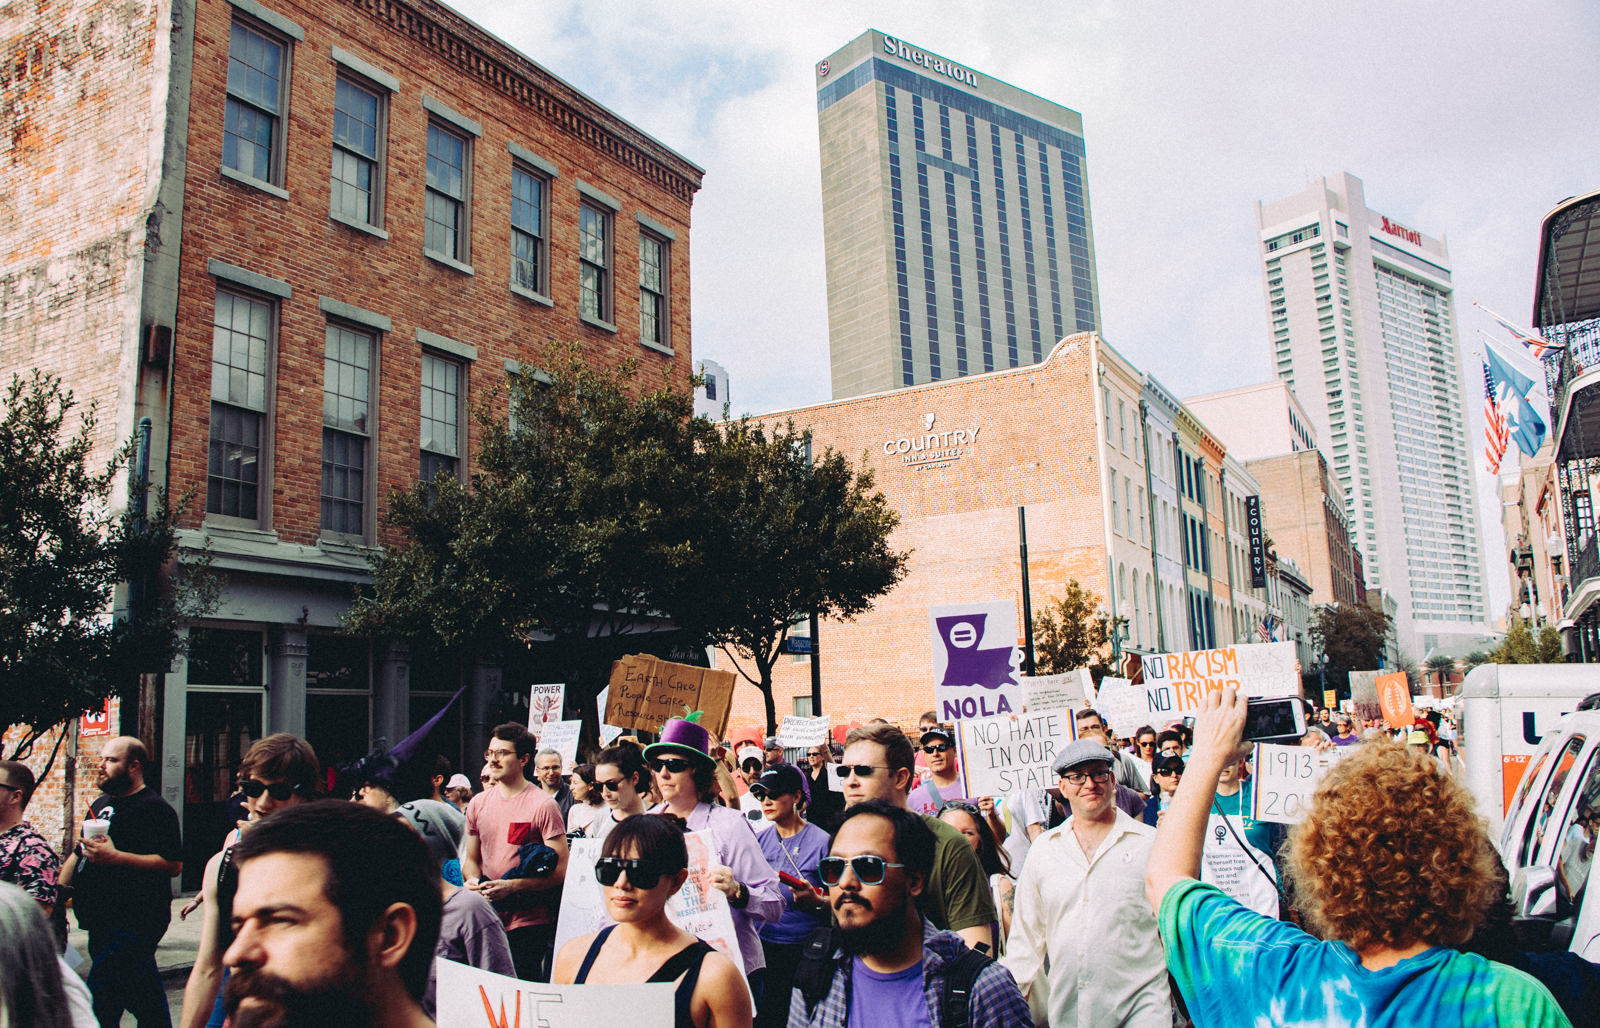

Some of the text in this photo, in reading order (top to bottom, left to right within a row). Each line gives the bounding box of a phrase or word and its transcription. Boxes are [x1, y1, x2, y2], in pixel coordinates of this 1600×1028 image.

[883, 35, 978, 88] Sheraton
[1381, 215, 1422, 247] Marriott
[902, 454, 918, 463] INN
[930, 449, 963, 459] SUITES
[1143, 648, 1239, 680] NO RACISM
[534, 685, 561, 694] POWER
[1147, 687, 1171, 713] NO
[943, 693, 1013, 721] NOLA
[783, 717, 808, 726] PROTECT
[973, 715, 1061, 746] NO HATE
[986, 741, 1058, 769] IN OUR
[1270, 752, 1313, 778] 1913
[998, 765, 1060, 792] STATE
[681, 884, 703, 897] IS IN
[683, 894, 706, 908] THE
[676, 902, 717, 918] RESISTANCE
